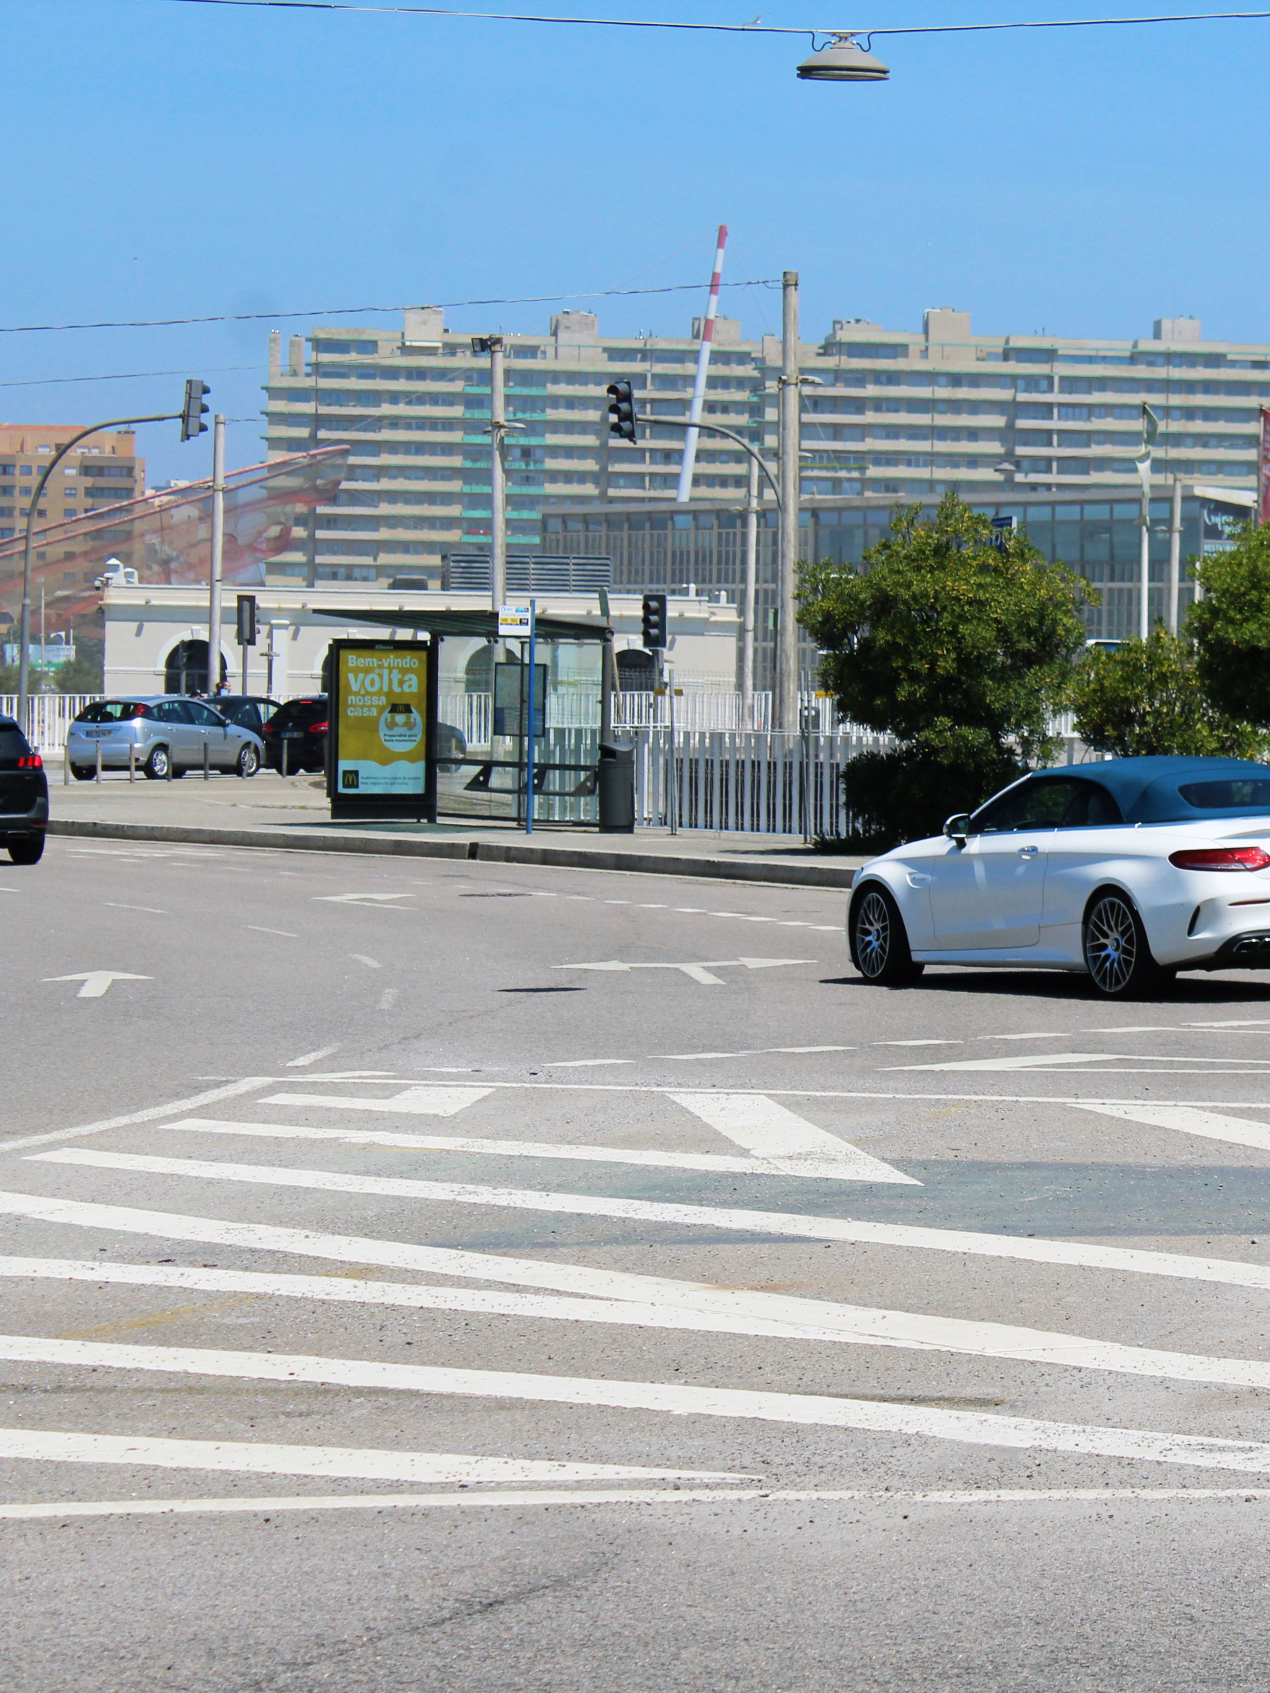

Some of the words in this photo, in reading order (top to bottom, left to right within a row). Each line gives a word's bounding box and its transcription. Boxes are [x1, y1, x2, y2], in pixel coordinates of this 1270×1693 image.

[348, 655, 419, 668] Bem-vindo
[348, 669, 419, 693] volta
[347, 695, 387, 705] nossa
[347, 707, 378, 717] casa
